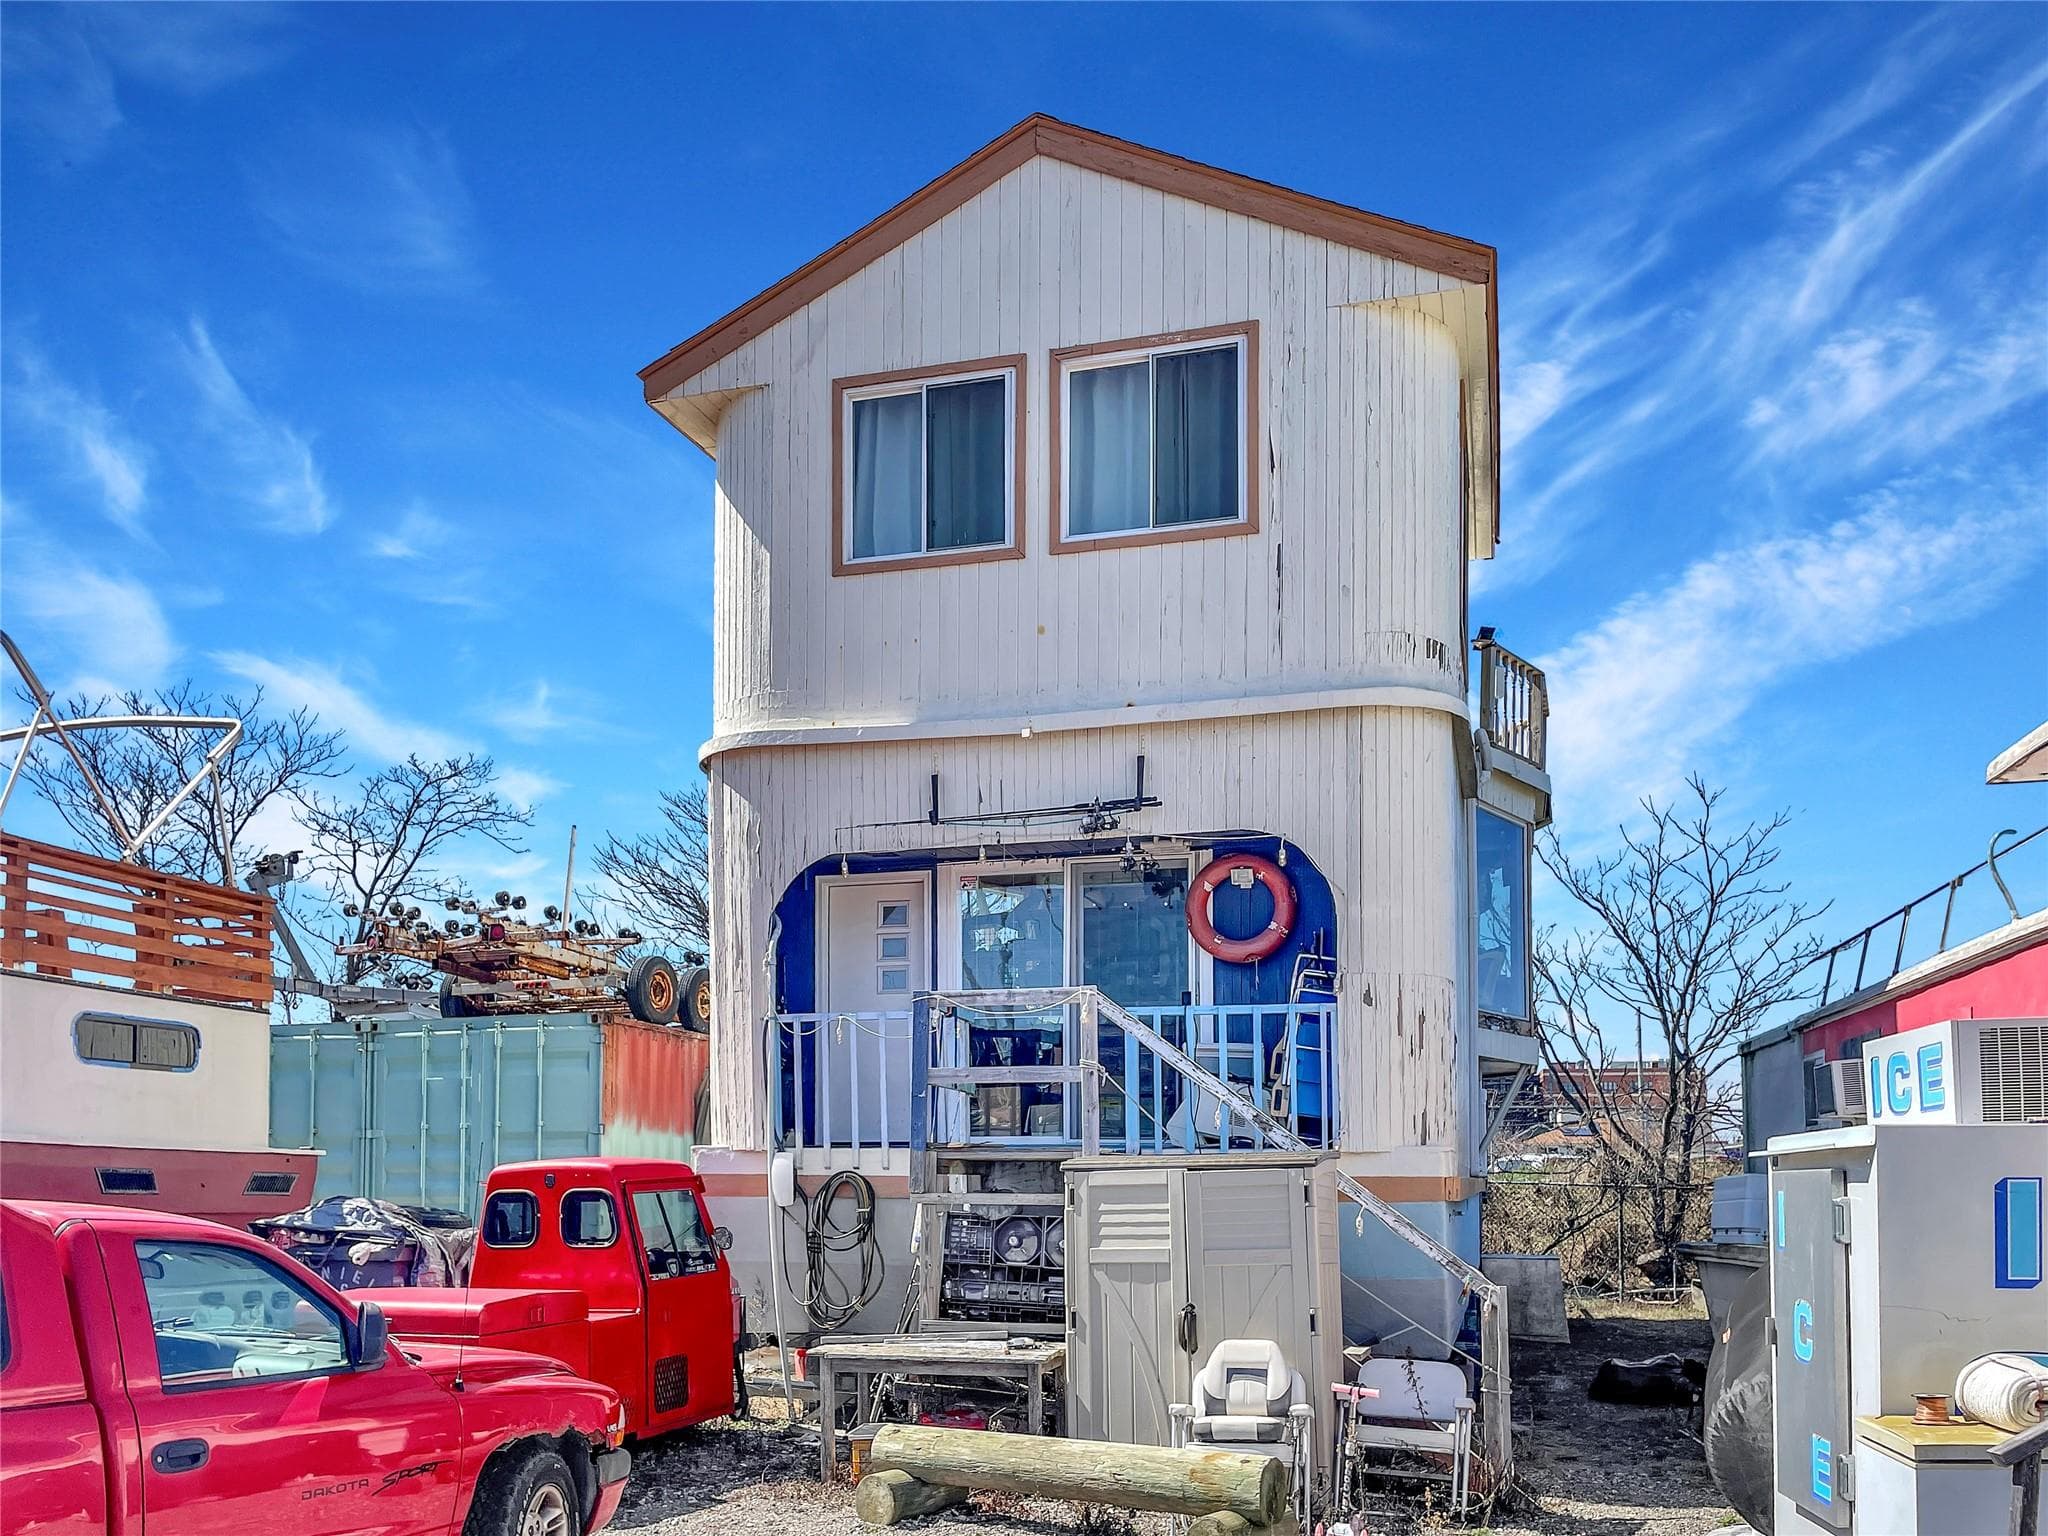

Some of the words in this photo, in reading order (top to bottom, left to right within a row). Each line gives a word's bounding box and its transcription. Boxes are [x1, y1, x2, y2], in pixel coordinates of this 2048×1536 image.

[1870, 1041, 1946, 1119] ICE
[301, 1478, 370, 1501] DAKOTA
[371, 1459, 454, 1497] SPORT
